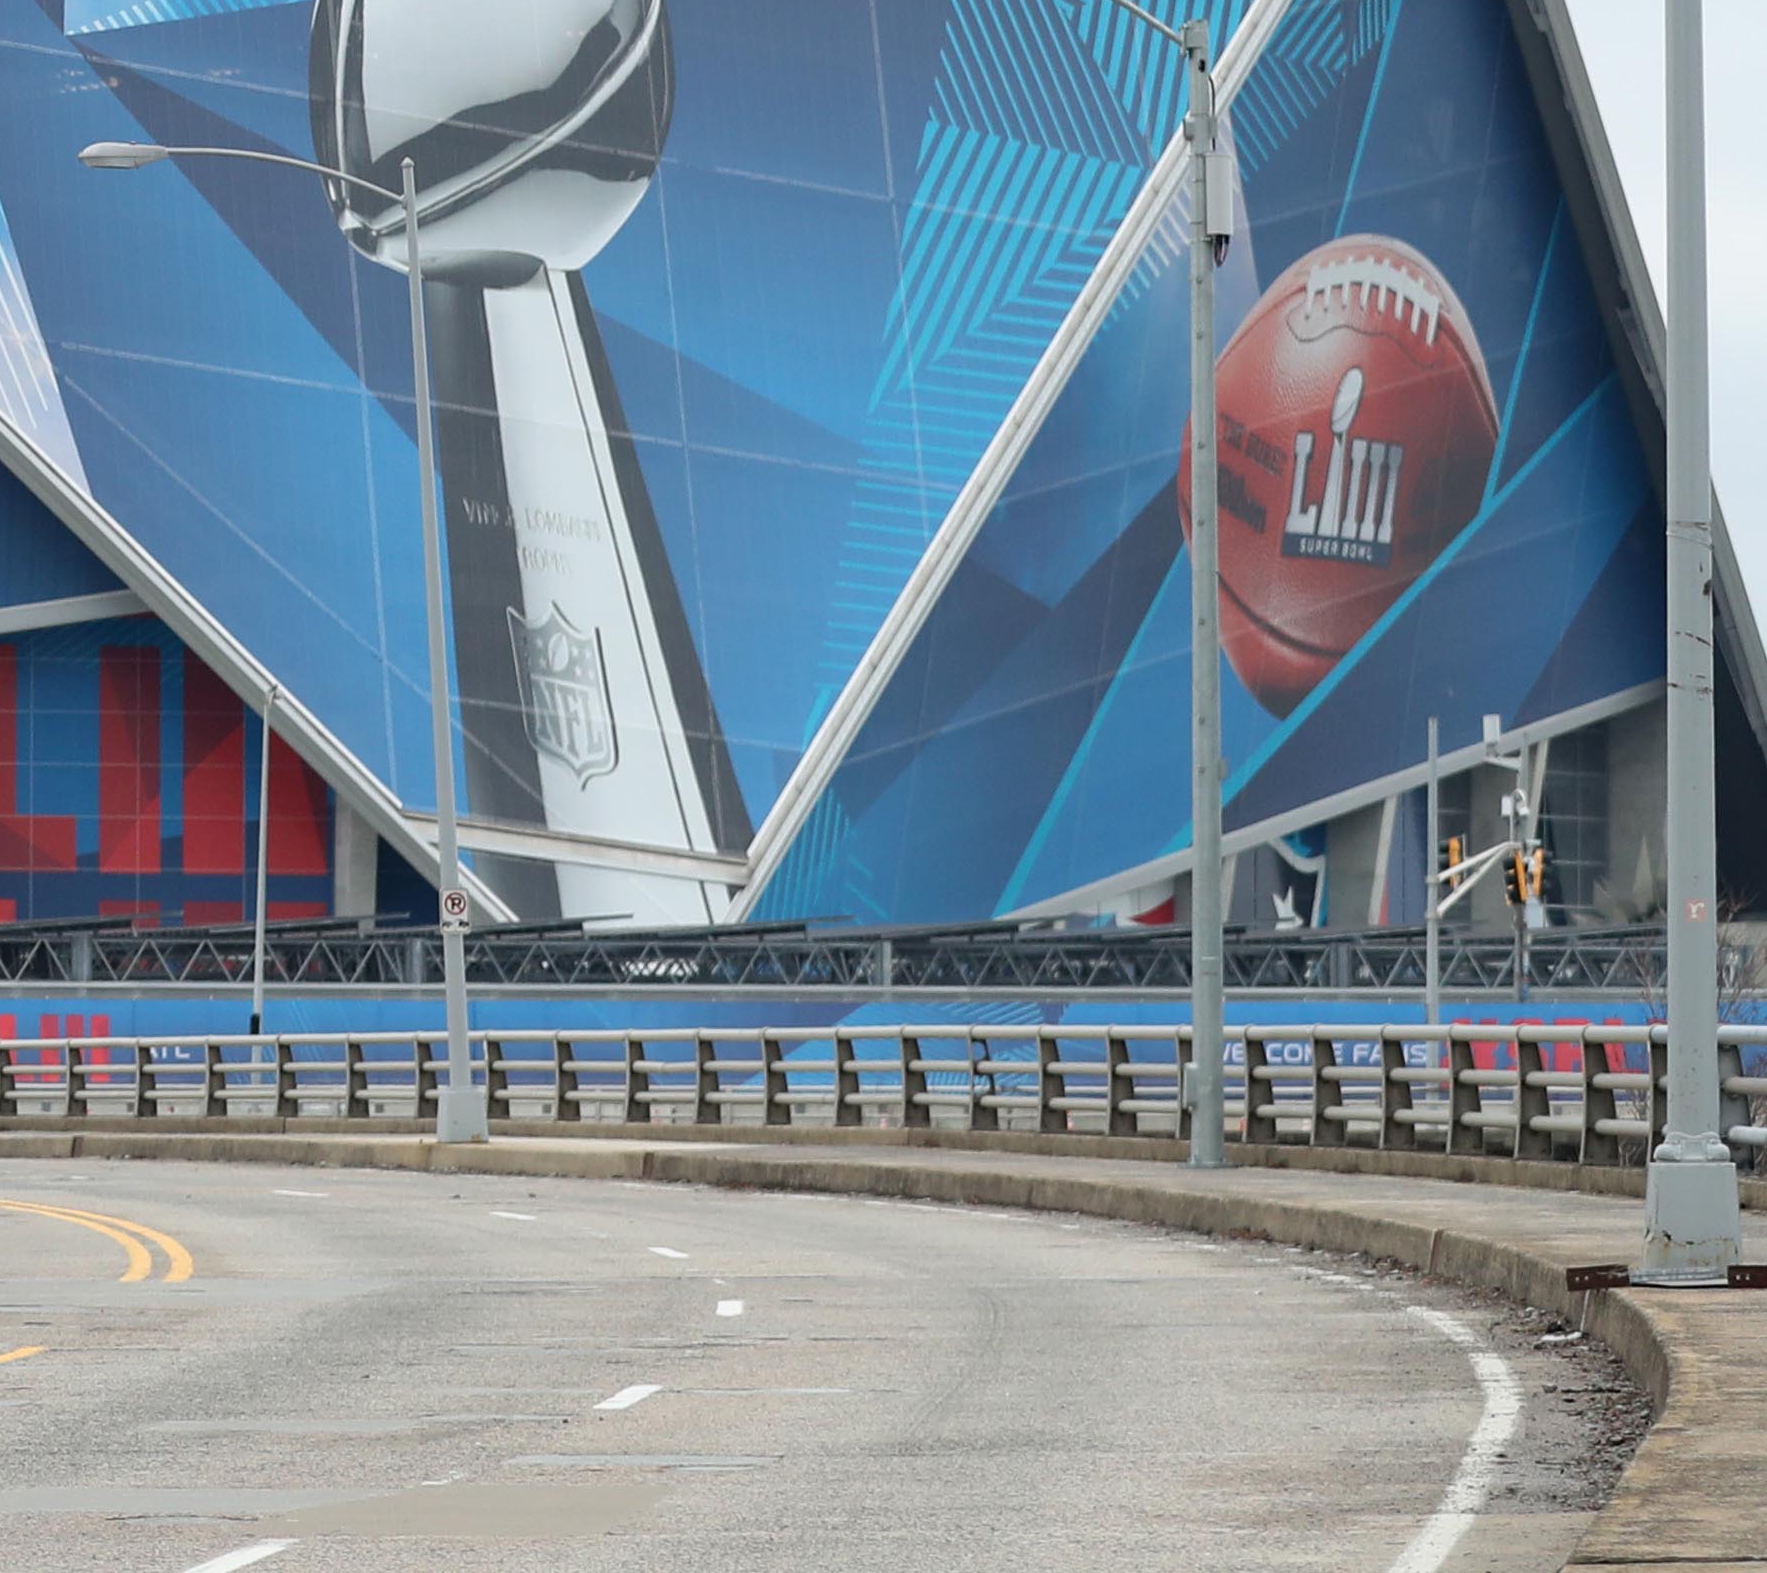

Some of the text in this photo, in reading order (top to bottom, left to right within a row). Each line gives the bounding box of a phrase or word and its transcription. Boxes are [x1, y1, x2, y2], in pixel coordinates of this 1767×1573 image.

[1299, 537, 1373, 562] SUPER BOWL
[530, 681, 605, 761] NFL
